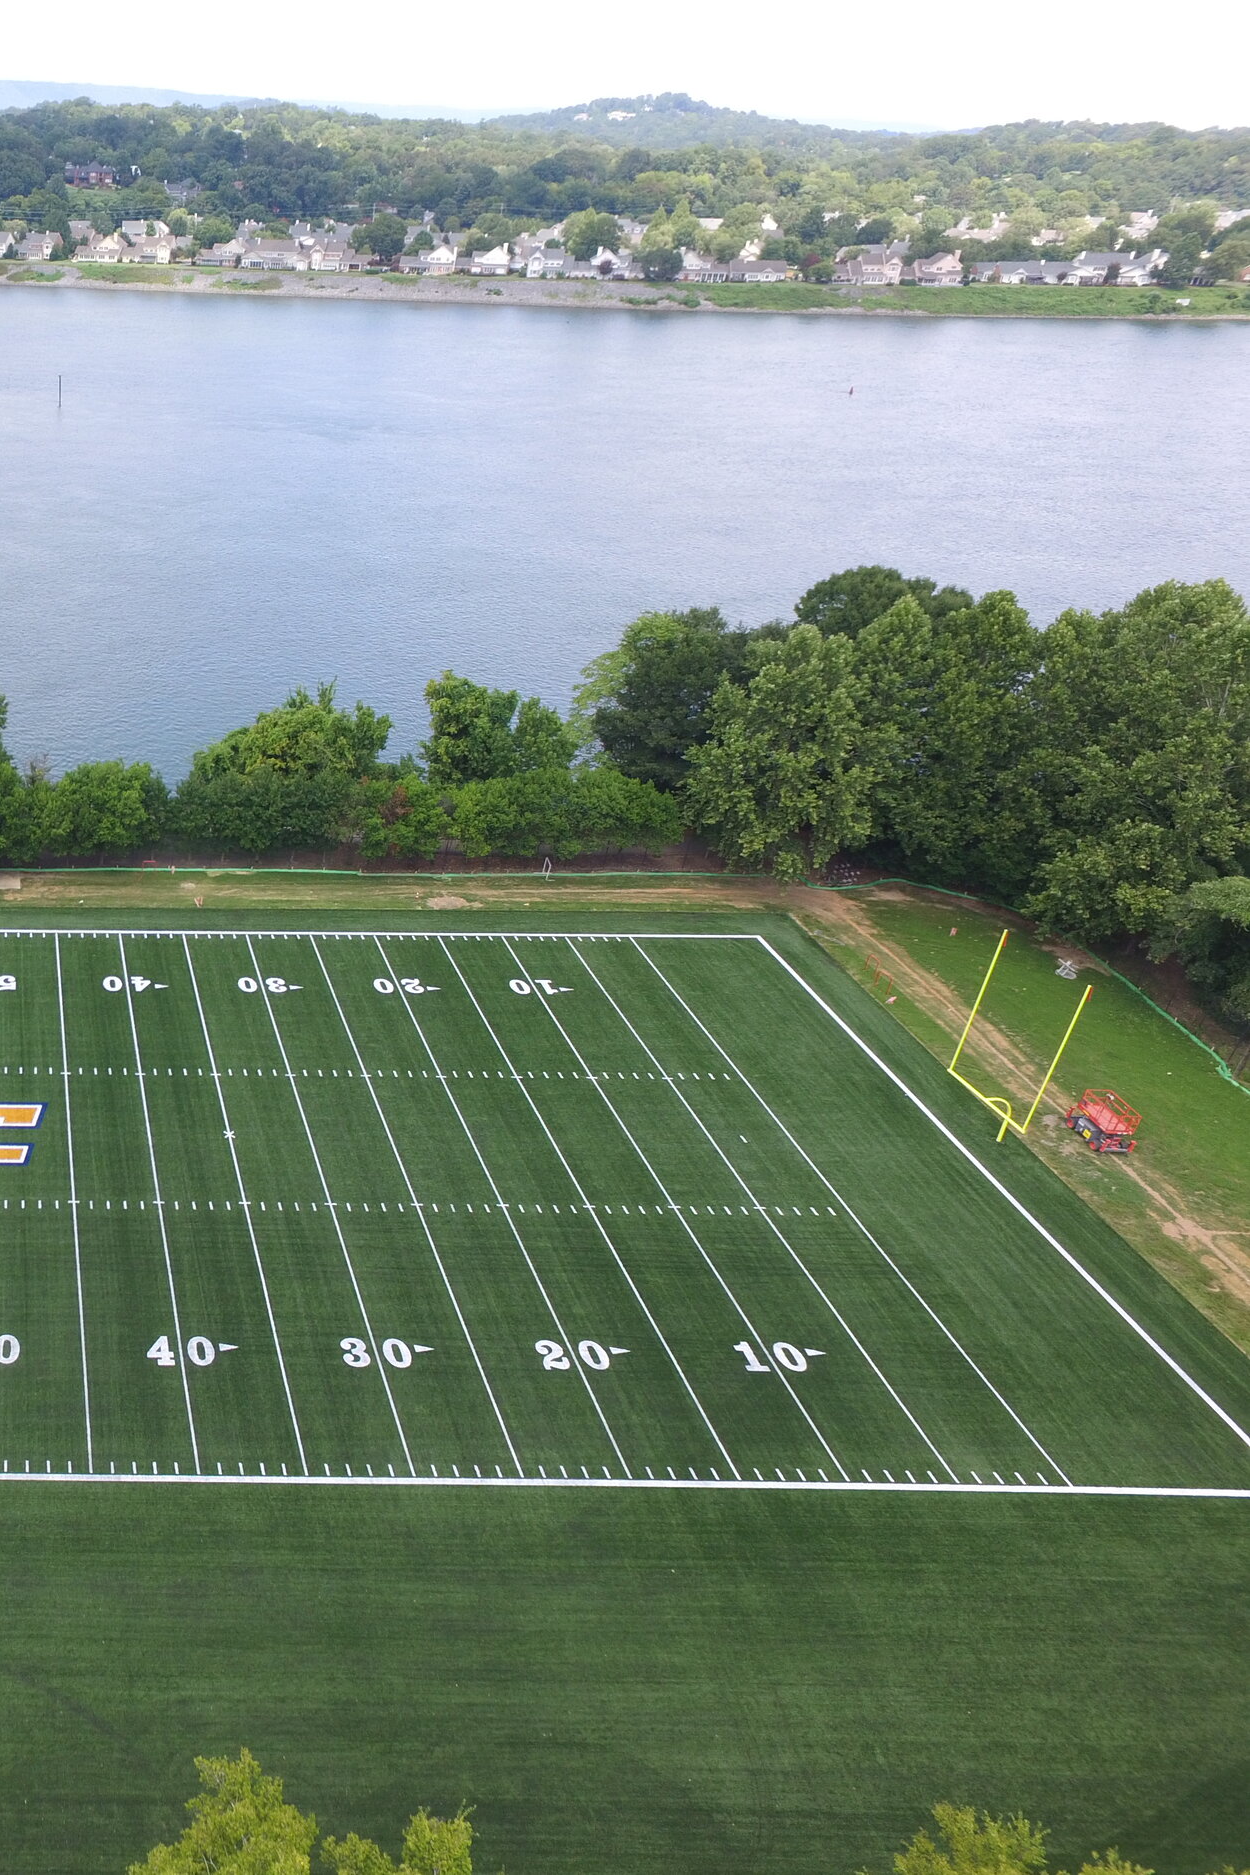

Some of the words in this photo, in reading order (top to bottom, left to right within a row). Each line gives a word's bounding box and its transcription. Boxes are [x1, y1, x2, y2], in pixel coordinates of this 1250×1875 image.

[102, 975, 152, 992] 40
[237, 976, 288, 993] 30
[372, 977, 425, 994] 20
[508, 978, 559, 995] 10
[146, 1335, 216, 1367] 40
[339, 1337, 413, 1369] 30
[534, 1339, 611, 1371] 20
[733, 1341, 808, 1373] 10
